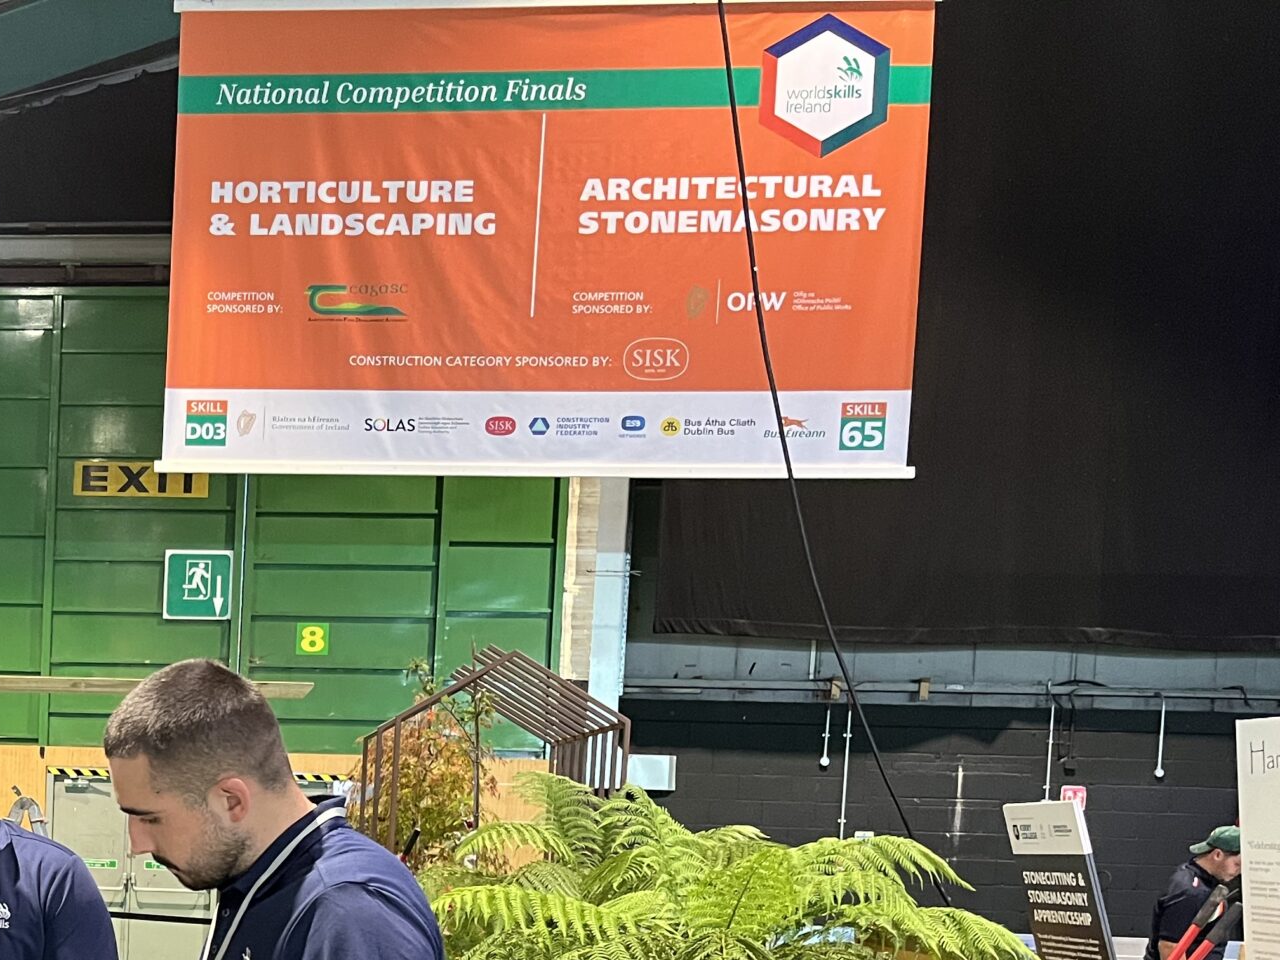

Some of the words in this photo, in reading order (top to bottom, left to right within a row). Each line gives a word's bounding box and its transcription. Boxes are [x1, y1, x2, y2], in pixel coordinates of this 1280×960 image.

[216, 81, 329, 106] National
[336, 80, 497, 109] Competition
[503, 77, 587, 102] Finals
[786, 84, 862, 100] worldskills
[786, 99, 832, 114] Ireland
[210, 179, 474, 204] HORTICULTURE
[579, 174, 882, 201] ARCHITECTURAL
[208, 213, 236, 236] &
[249, 211, 496, 236] LANDSCAPING
[577, 207, 886, 235] STONEMASONRY
[207, 291, 274, 301] COMPETITION
[572, 291, 644, 301] COMPETITION
[726, 291, 787, 312] OPW
[206, 304, 265, 314] SPONSORED
[267, 304, 283, 314] BY:
[571, 304, 634, 314] SPONSORED
[636, 305, 653, 314] BY:
[348, 355, 442, 367] CONSTRUCTION
[445, 356, 512, 367] CATEGORY
[515, 355, 588, 367] SPONSORED
[592, 356, 612, 367] BY:
[631, 348, 681, 368] SISK
[190, 401, 223, 413] SKILL
[845, 404, 882, 416] SKILL
[364, 418, 415, 432] SOLAS
[488, 420, 513, 431] SISK
[684, 419, 704, 427] Bus
[705, 417, 727, 427] Átha
[729, 419, 756, 427] Cliath
[186, 422, 226, 440] D03
[683, 428, 714, 436] Dublin
[716, 428, 735, 436] Bus
[841, 421, 883, 448] 65
[300, 626, 325, 653] 8
[1023, 871, 1077, 887] STONECUTTING
[1078, 872, 1086, 887] &
[1027, 890, 1089, 907] STONEMASONRY
[1033, 908, 1092, 926] APPRENTICESHIP
